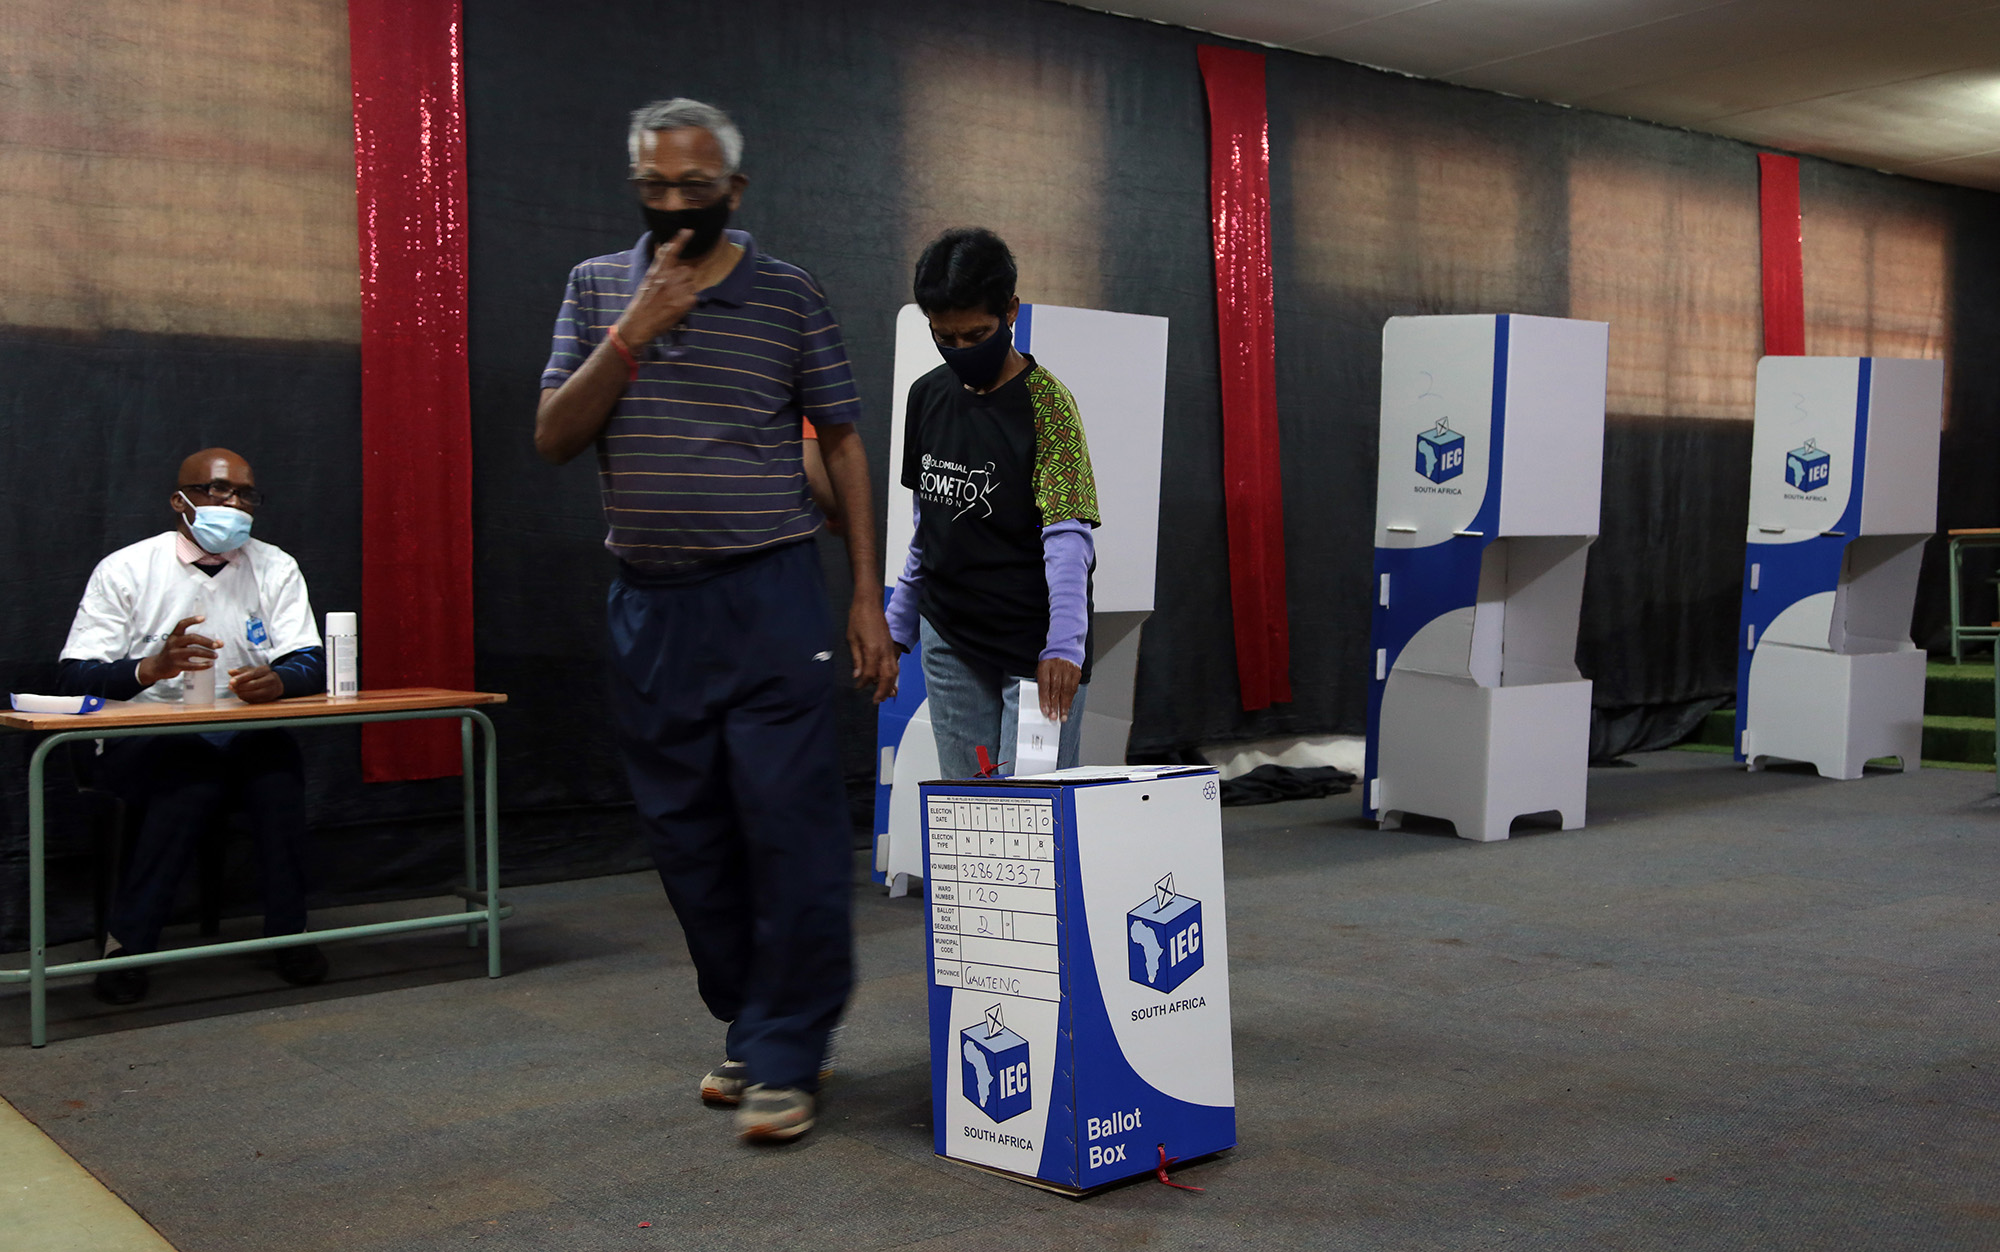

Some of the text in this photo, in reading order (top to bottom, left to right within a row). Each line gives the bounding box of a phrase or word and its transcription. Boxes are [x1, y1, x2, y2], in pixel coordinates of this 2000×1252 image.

[1441, 448, 1462, 471] IEC
[1809, 463, 1828, 482] IEC
[1414, 486, 1462, 495] SOUTH AFRICA
[1026, 817, 1033, 828] 2
[938, 863, 956, 871] NUMBER
[962, 862, 1040, 885] 32862337
[935, 893, 955, 901] NUMBER
[968, 887, 998, 903] 120
[934, 923, 958, 931] SEQUENCE
[935, 938, 959, 946] MUNICIPAL
[1170, 922, 1200, 968] IEC
[937, 969, 960, 978] PROVINCE
[1131, 996, 1206, 1022] SOUTH AFRICA
[999, 1062, 1028, 1100] IEC
[1088, 1107, 1142, 1141] Ballot
[964, 1126, 1033, 1151] SOUTH AFRICA
[1089, 1143, 1127, 1169] Box
